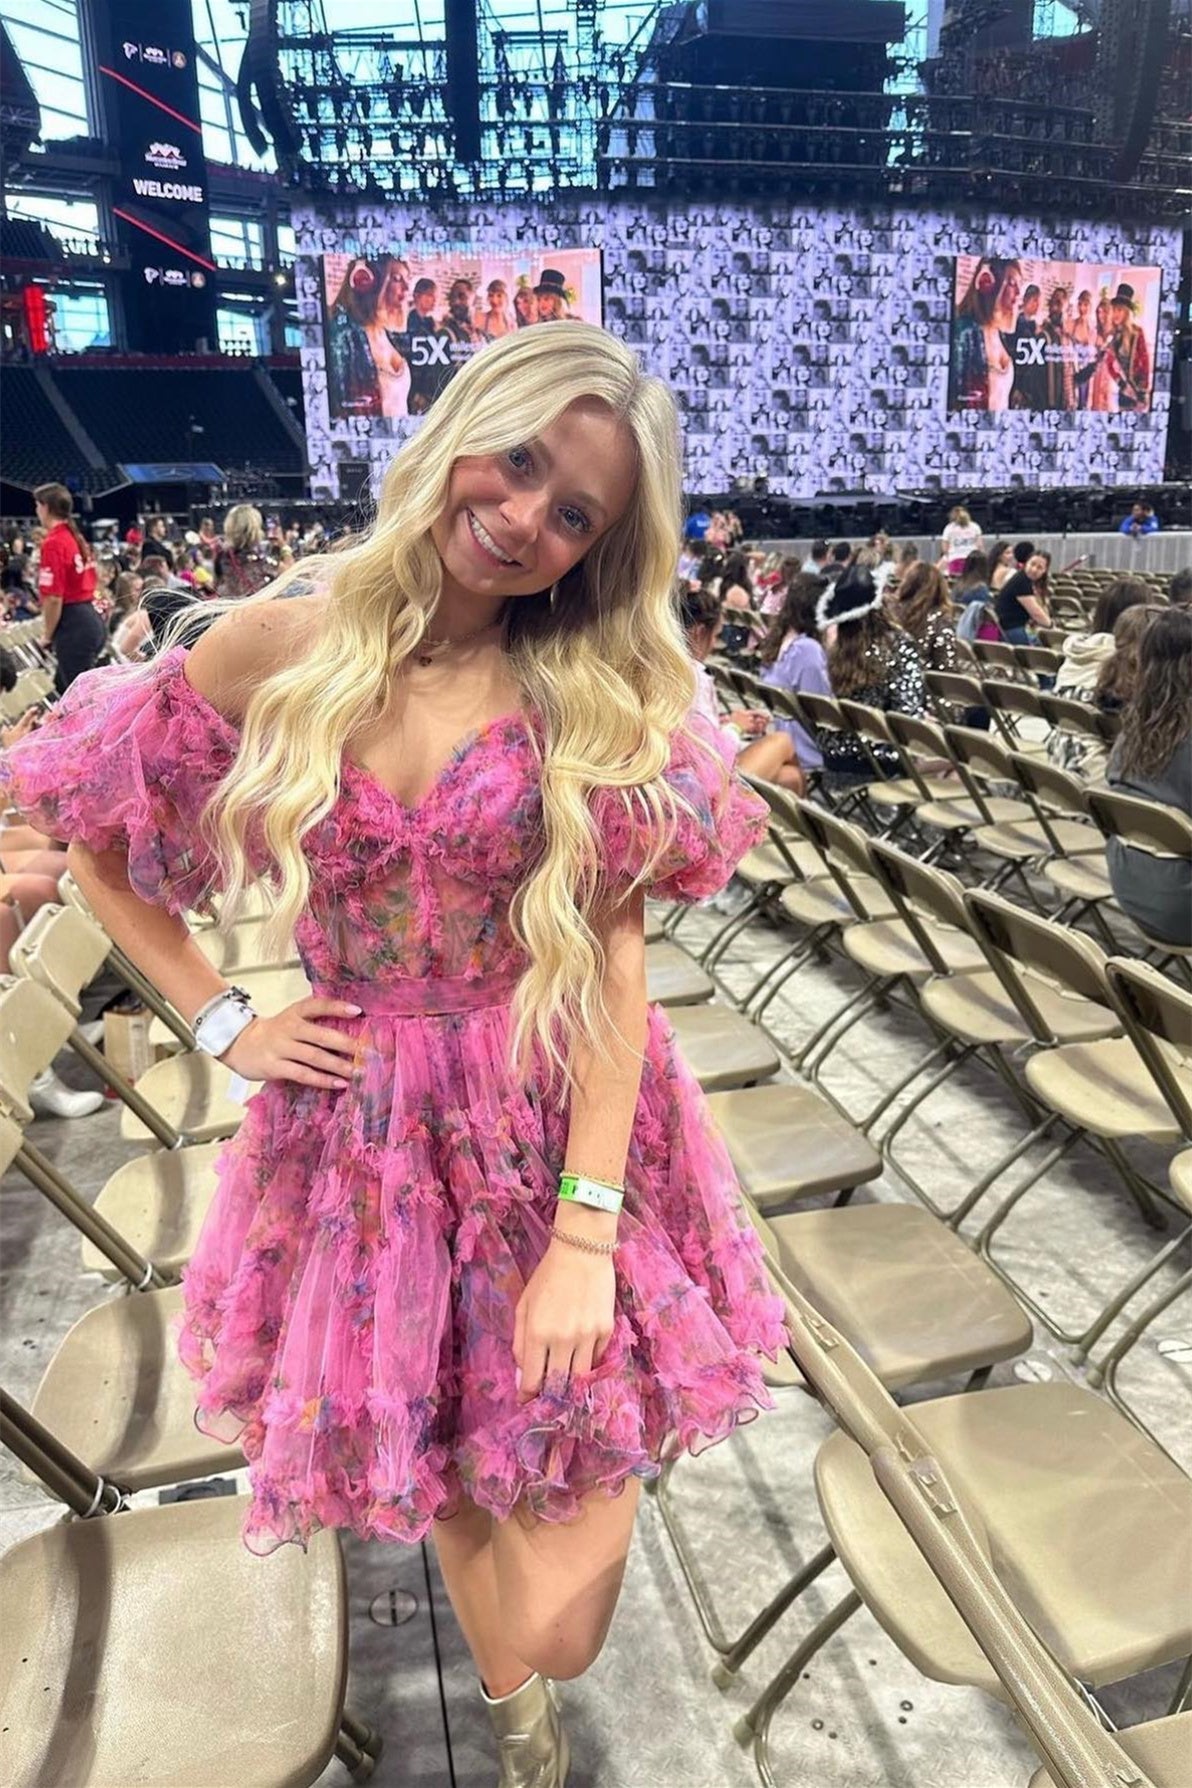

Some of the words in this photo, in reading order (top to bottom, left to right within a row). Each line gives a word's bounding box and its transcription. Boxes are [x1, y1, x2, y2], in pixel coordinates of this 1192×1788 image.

[133, 179, 203, 202] WELCOME
[411, 336, 451, 366] 5X
[1015, 338, 1045, 365] 5X
